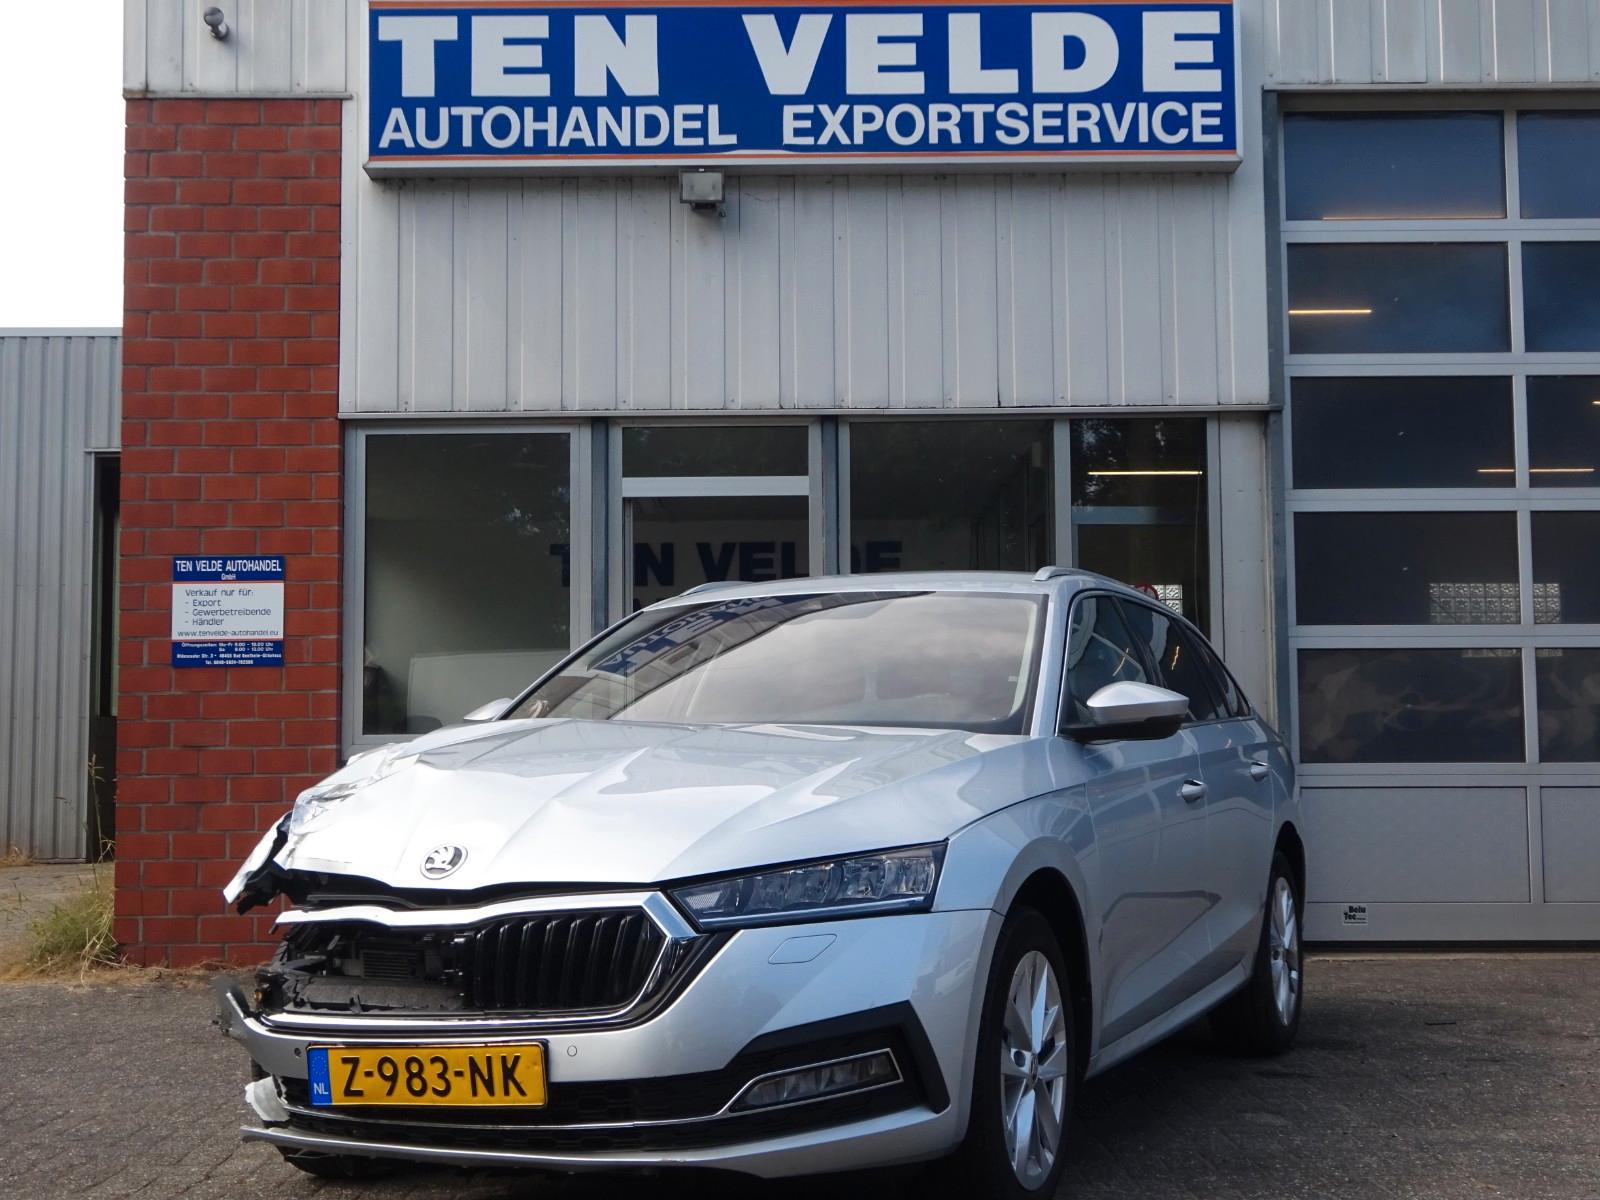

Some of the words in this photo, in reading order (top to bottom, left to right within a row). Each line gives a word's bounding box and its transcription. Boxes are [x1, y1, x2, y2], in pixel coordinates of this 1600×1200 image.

[378, 14, 660, 98] TEN
[741, 11, 1223, 96] VELDE
[378, 104, 738, 149] AUTOHANDEL
[783, 101, 1224, 146] EXPORTSERVICE
[176, 561, 193, 572] TEN
[196, 560, 223, 572] VELDE
[226, 560, 282, 572] AUTOHANDEL
[550, 542, 675, 586] TN
[185, 588, 218, 597] Verkauf
[221, 589, 235, 597] nur
[192, 599, 221, 608] Export
[192, 607, 272, 616] Gewerbetreibende
[192, 617, 224, 626] Händler
[341, 1054, 528, 1098] Z-983-NK
[313, 1082, 329, 1095] NL
